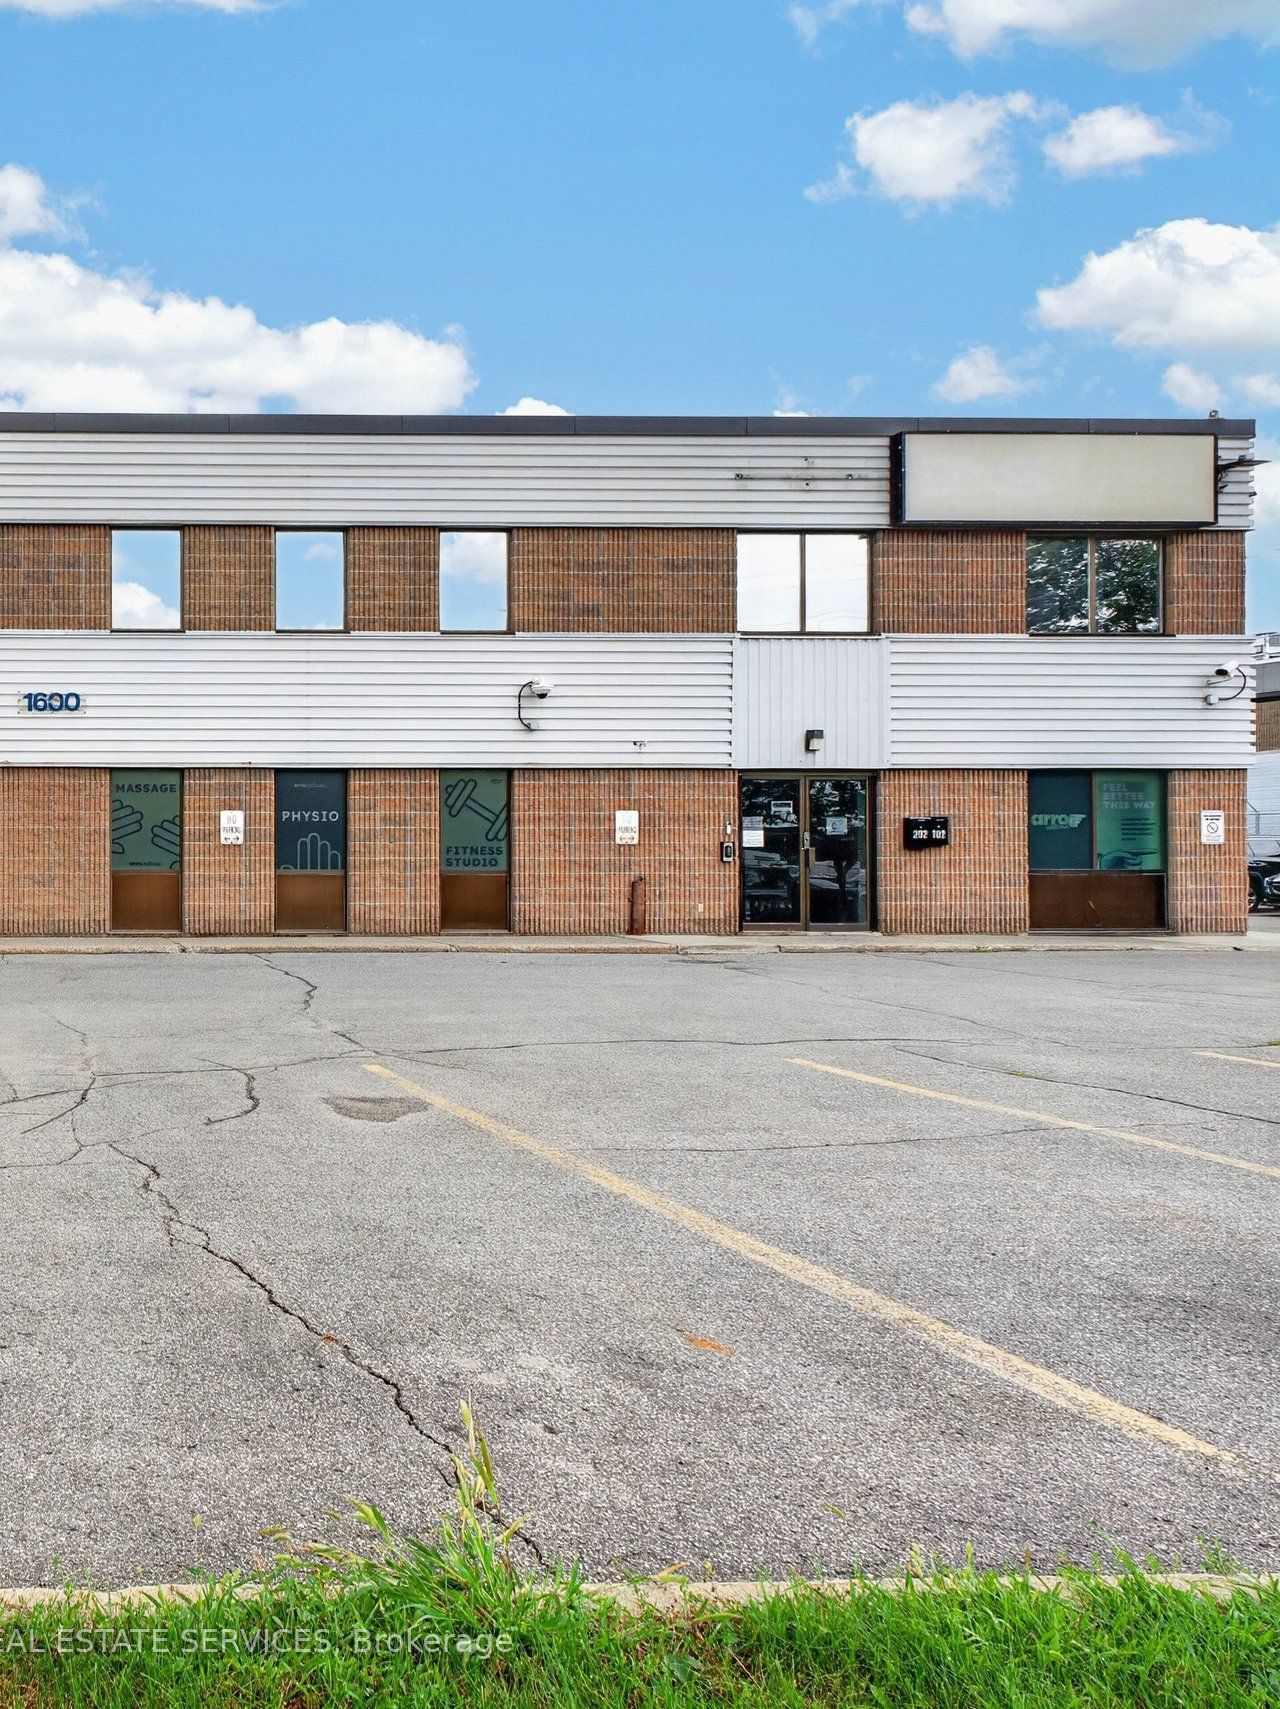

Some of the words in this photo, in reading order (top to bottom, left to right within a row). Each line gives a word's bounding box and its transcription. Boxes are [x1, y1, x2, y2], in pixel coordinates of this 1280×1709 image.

[23, 692, 80, 712] 1600
[115, 783, 177, 794] MASSAGE
[1133, 801, 1156, 809] WAY
[281, 810, 339, 822] PHYSIO
[446, 846, 503, 856] FITNESS
[445, 858, 498, 867] STUDIO
